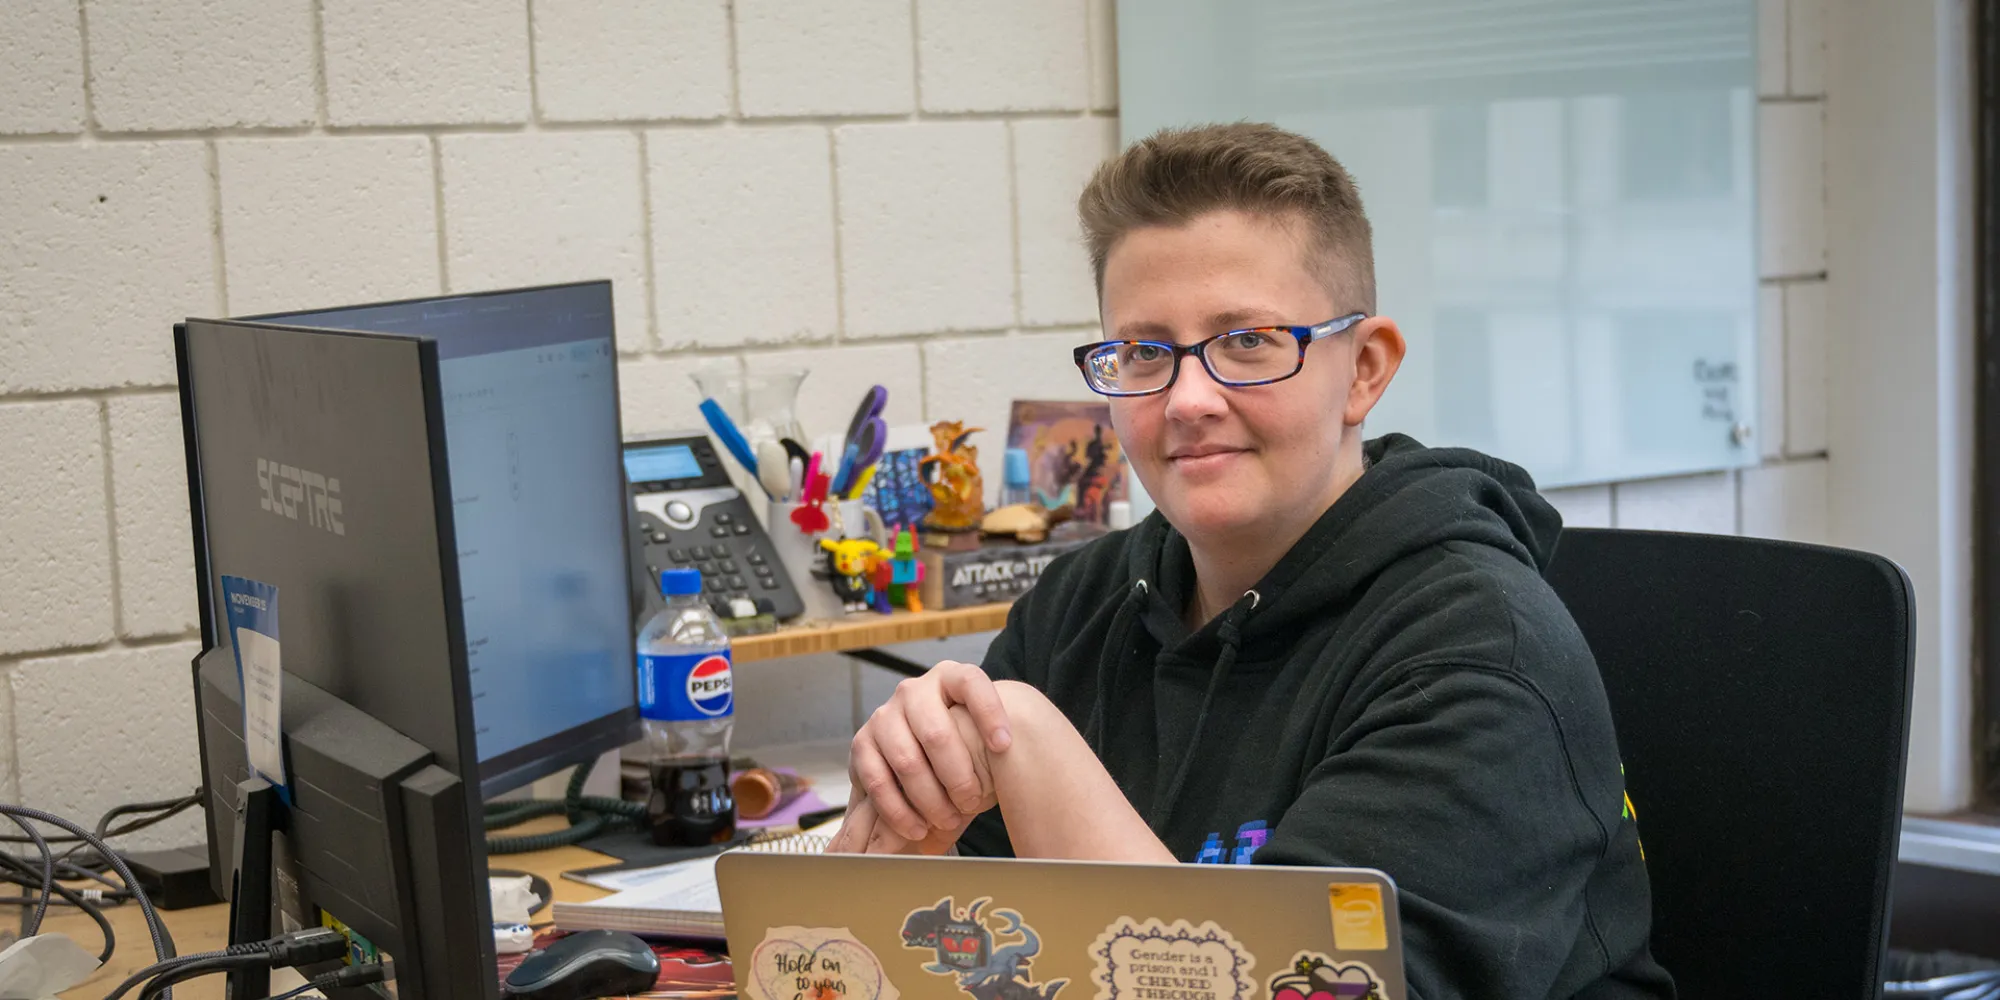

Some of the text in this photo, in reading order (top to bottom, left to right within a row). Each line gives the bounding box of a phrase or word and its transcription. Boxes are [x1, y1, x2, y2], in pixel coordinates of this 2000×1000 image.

[257, 458, 345, 536] SCEPTRE
[952, 561, 1014, 587] ATTACK
[692, 678, 731, 693] PEPS
[774, 953, 841, 974] Hold on
[1130, 949, 1213, 964] Gender is a
[1129, 963, 1175, 974] prison
[1179, 964, 1208, 976] and
[796, 976, 810, 990] to
[814, 978, 846, 997] your
[1136, 975, 1212, 989] CHEWED
[1132, 987, 1216, 1000] THROUGH
